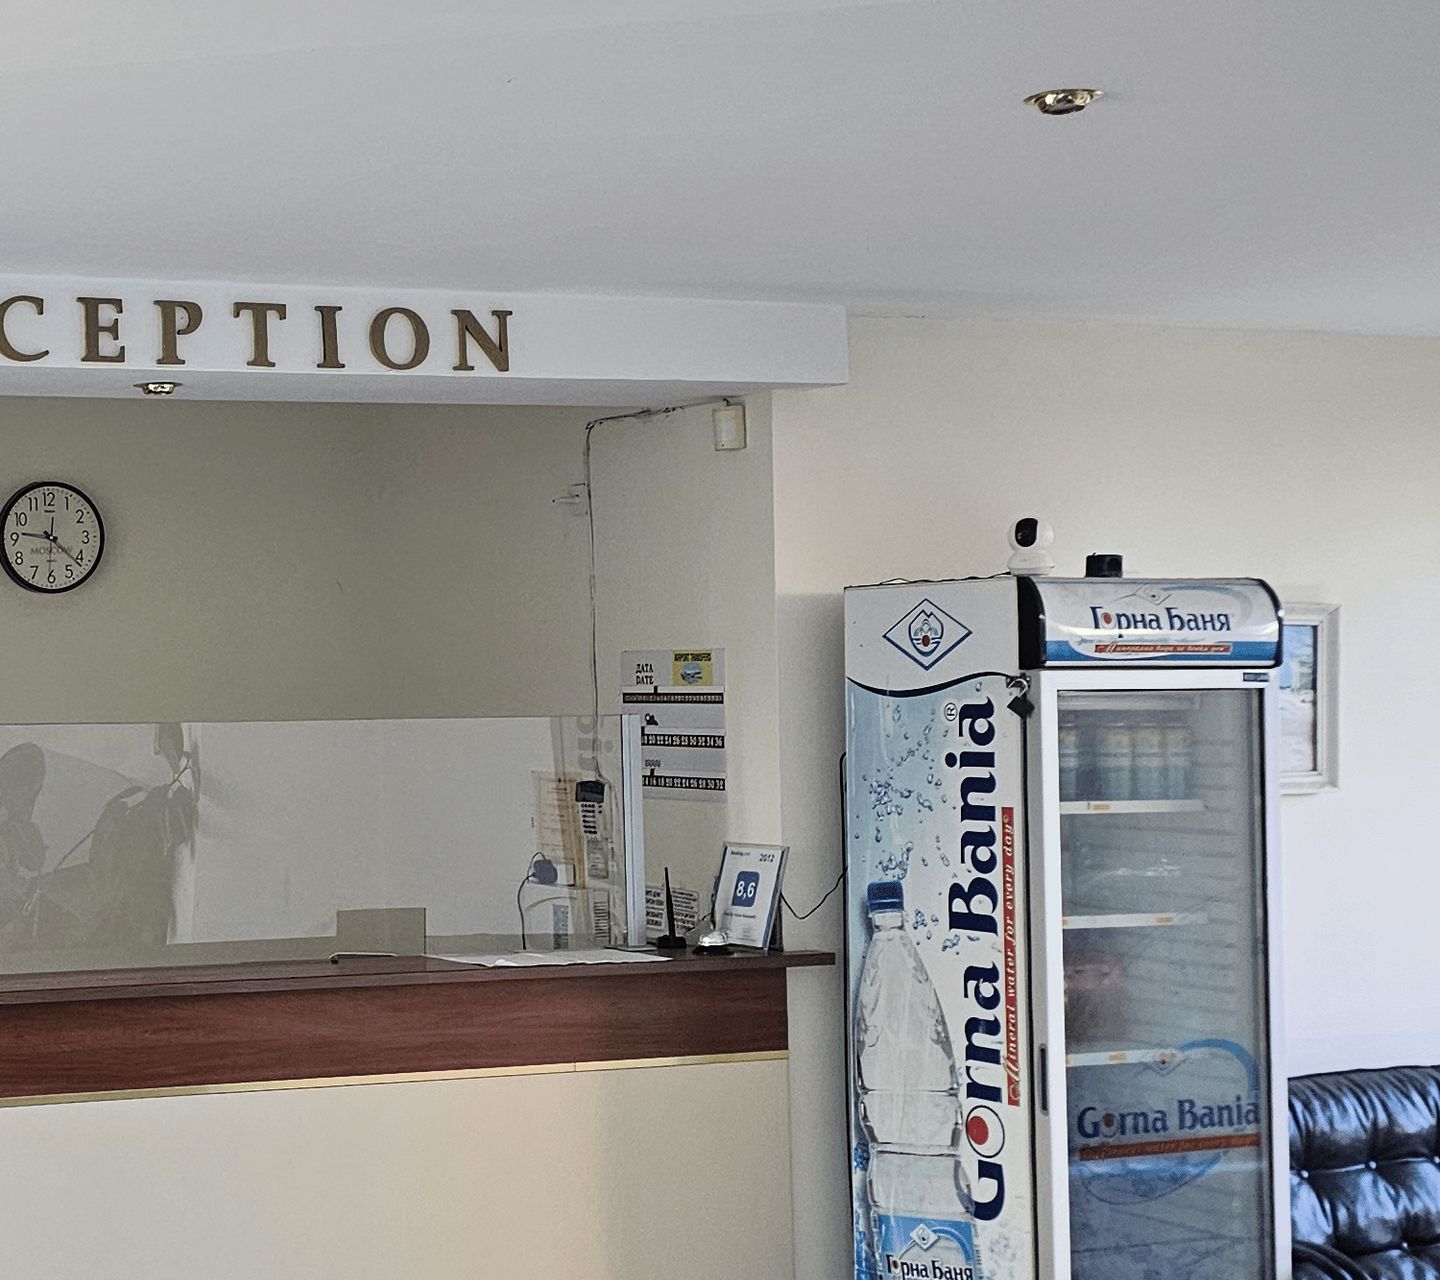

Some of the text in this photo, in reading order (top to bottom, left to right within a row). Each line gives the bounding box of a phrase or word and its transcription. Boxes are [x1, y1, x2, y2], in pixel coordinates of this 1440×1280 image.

[28, 497, 38, 512] 11
[42, 492, 55, 507] 12
[14, 512, 27, 527] 10
[75, 509, 84, 524] 2
[10, 531, 19, 547] 9
[81, 530, 90, 544] 3
[15, 551, 24, 565] 8
[75, 548, 84, 562] 4
[30, 565, 39, 580] 7
[47, 569, 56, 584] 6
[65, 564, 74, 579] 5
[1089, 606, 1231, 639] Горна Баня
[635, 663, 654, 674] ДАТА
[635, 675, 654, 685] DATE
[759, 853, 775, 863] 2012
[736, 880, 757, 900] 8,6
[1003, 865, 1016, 911] every
[1003, 916, 1016, 945] for
[1004, 949, 1016, 997] water
[1001, 1004, 1021, 1102] Mineral
[964, 961, 1006, 1221] Gorna
[1076, 1094, 1260, 1139] Gorna Bania
[886, 1253, 930, 1280] Горна
